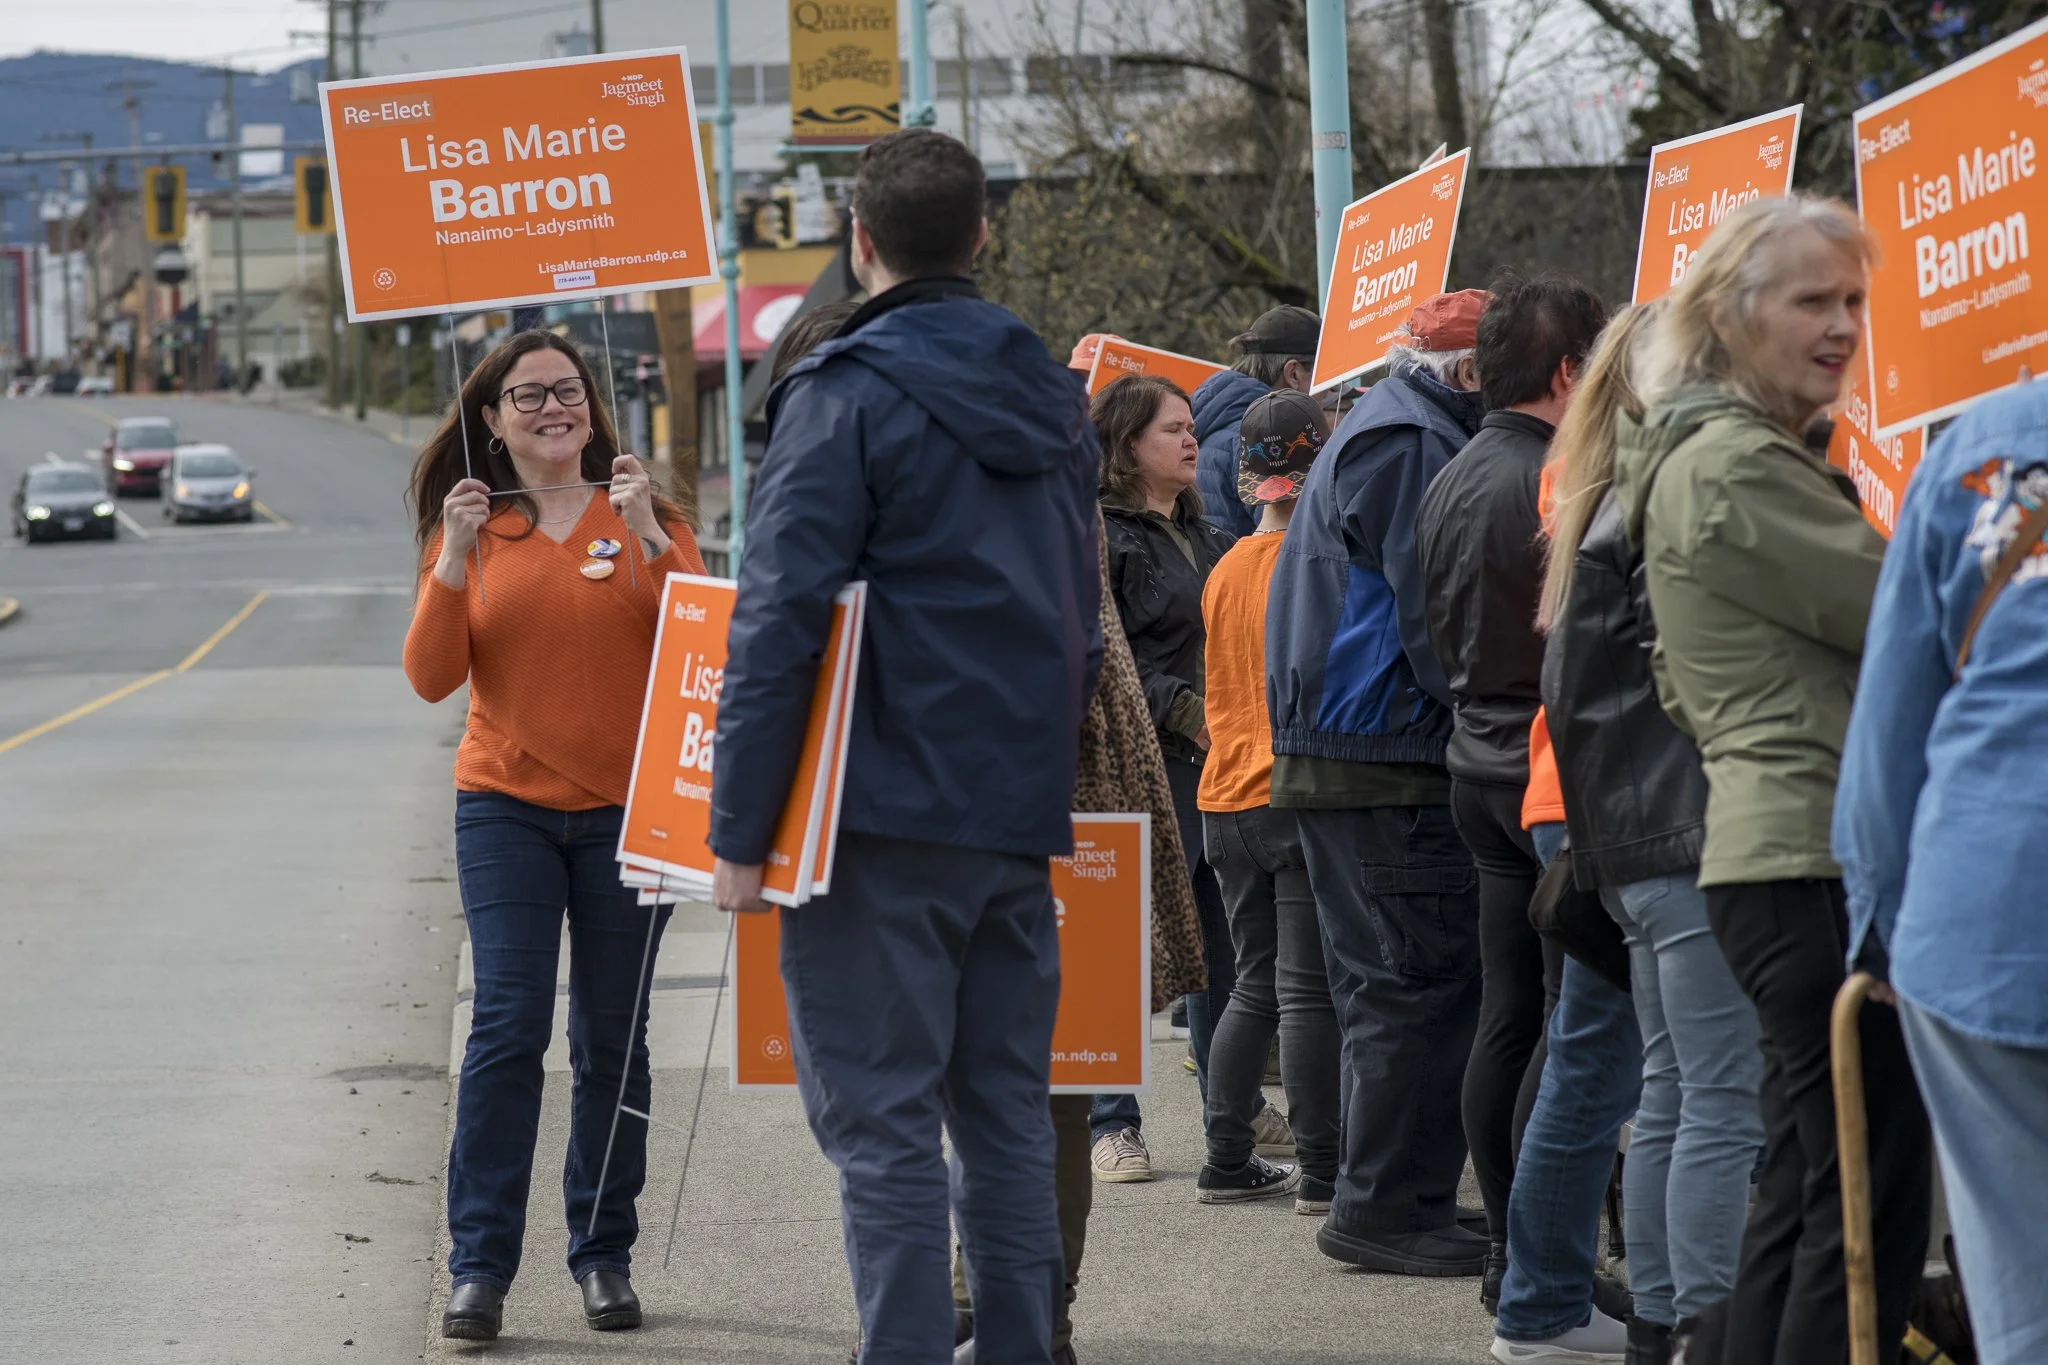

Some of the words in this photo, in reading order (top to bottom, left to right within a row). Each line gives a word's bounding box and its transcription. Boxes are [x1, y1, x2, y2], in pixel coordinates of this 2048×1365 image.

[601, 78, 664, 98] Jagmeet
[626, 91, 665, 107] Singh
[343, 100, 431, 125] Re-Elect
[400, 134, 490, 173] Lisa
[502, 117, 626, 162] Marie
[1859, 118, 1911, 163] Re-Elect
[1654, 164, 1690, 188] Re-Elect
[1898, 173, 1953, 231] Lisa
[1958, 129, 2036, 205] Marie
[429, 171, 612, 223] Barron
[1347, 212, 1370, 232] Re-Elect
[1668, 197, 1705, 236] Lisa
[1351, 239, 1384, 273] Lisa
[1386, 213, 1434, 257] Marie
[1915, 211, 2029, 299] Barron
[538, 249, 688, 274] LisaMarieBarron.ndp.ca
[1351, 259, 1418, 313] Barron
[1105, 351, 1145, 373] Re-Elect
[674, 602, 707, 623] Re-Elect
[1073, 863, 1117, 882] Singh
